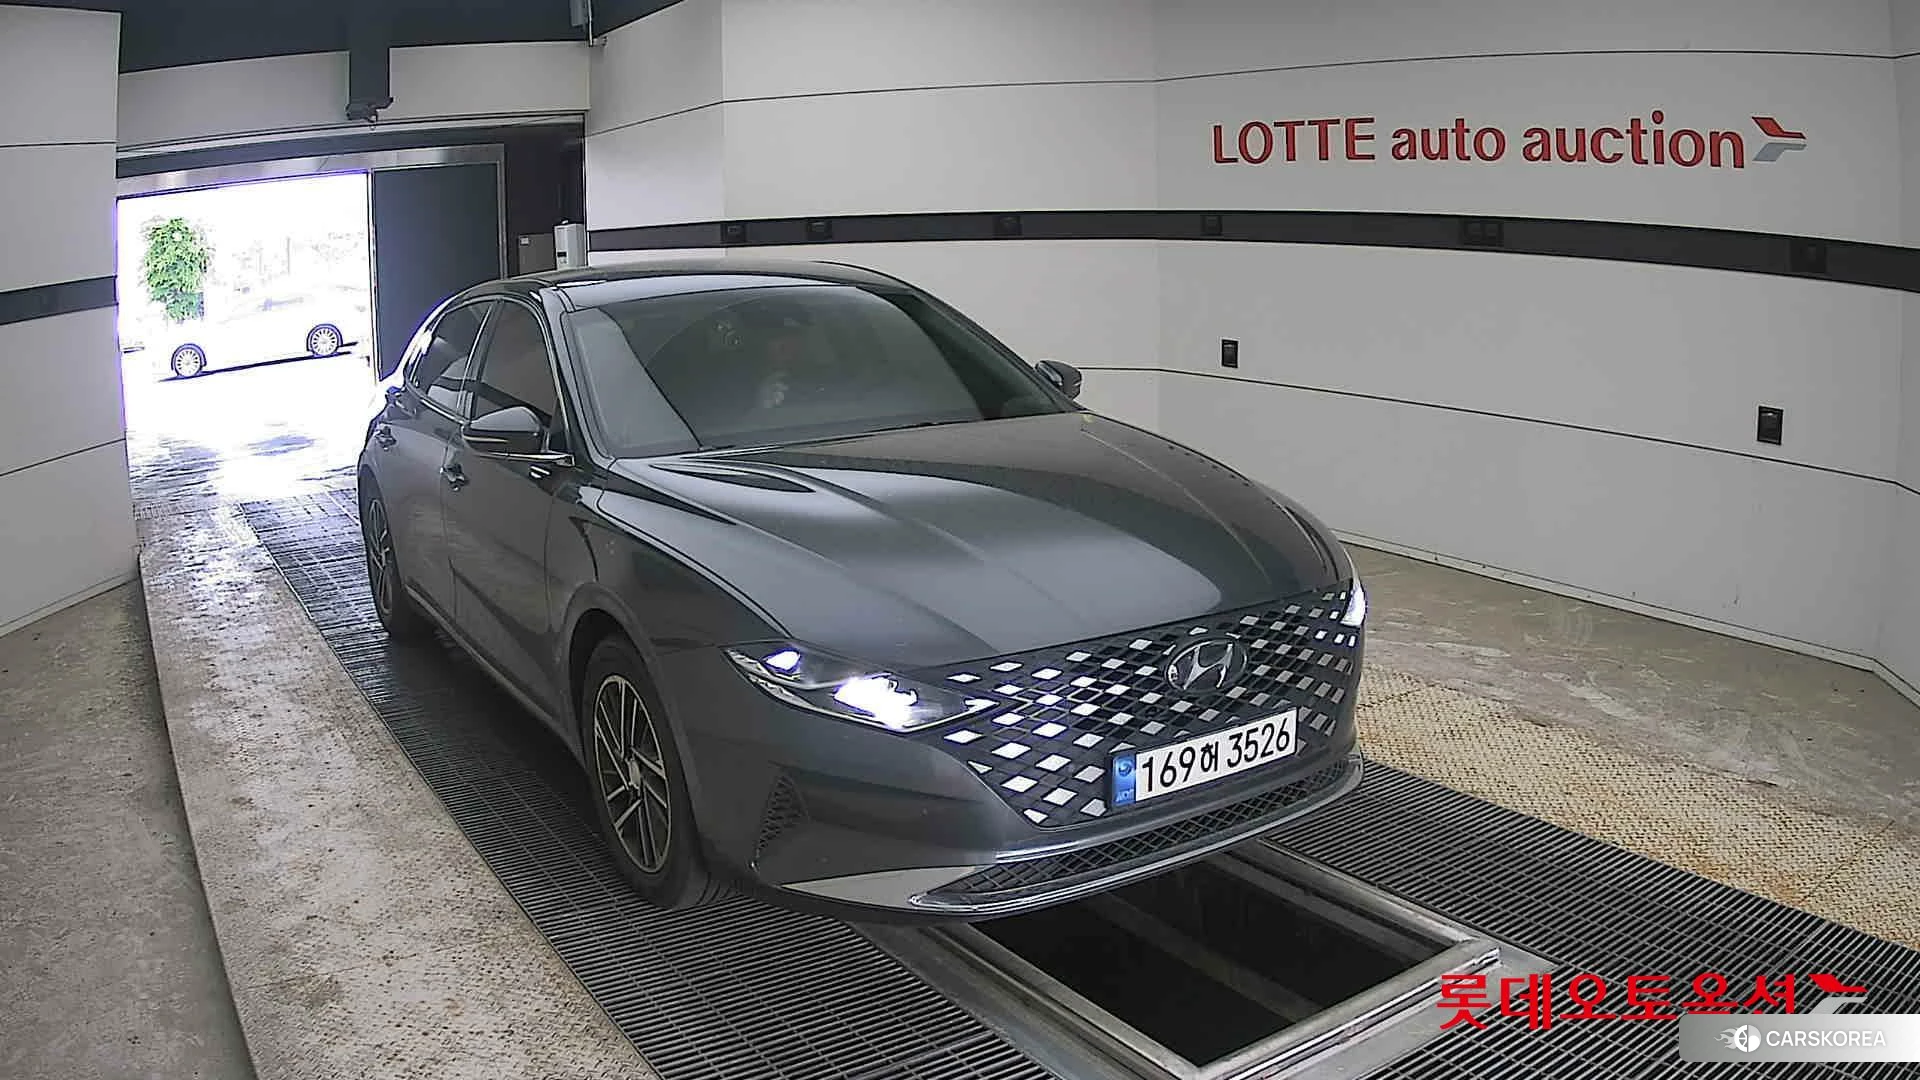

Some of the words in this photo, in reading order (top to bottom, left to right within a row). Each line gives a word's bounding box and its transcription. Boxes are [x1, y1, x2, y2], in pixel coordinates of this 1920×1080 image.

[1213, 117, 1375, 165] LOTTE
[1391, 118, 1506, 162] auto
[1522, 111, 1745, 169] auction
[1142, 741, 1219, 792] 169허
[1227, 718, 1290, 769] 3526
